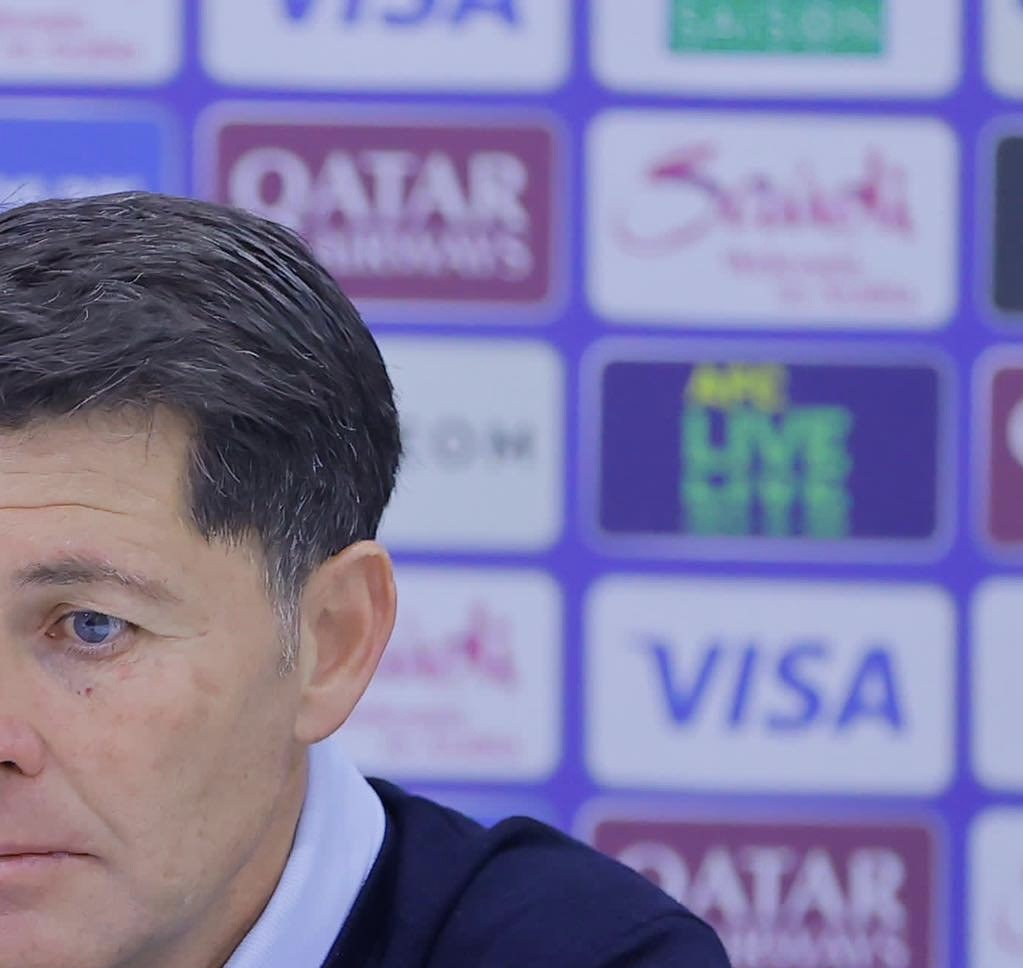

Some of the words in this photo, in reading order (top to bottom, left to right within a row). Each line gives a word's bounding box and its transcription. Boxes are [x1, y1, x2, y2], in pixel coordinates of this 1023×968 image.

[228, 148, 532, 232] QATAR
[400, 418, 538, 468] EOM
[682, 404, 852, 480] LIVE
[640, 632, 908, 734] VISA
